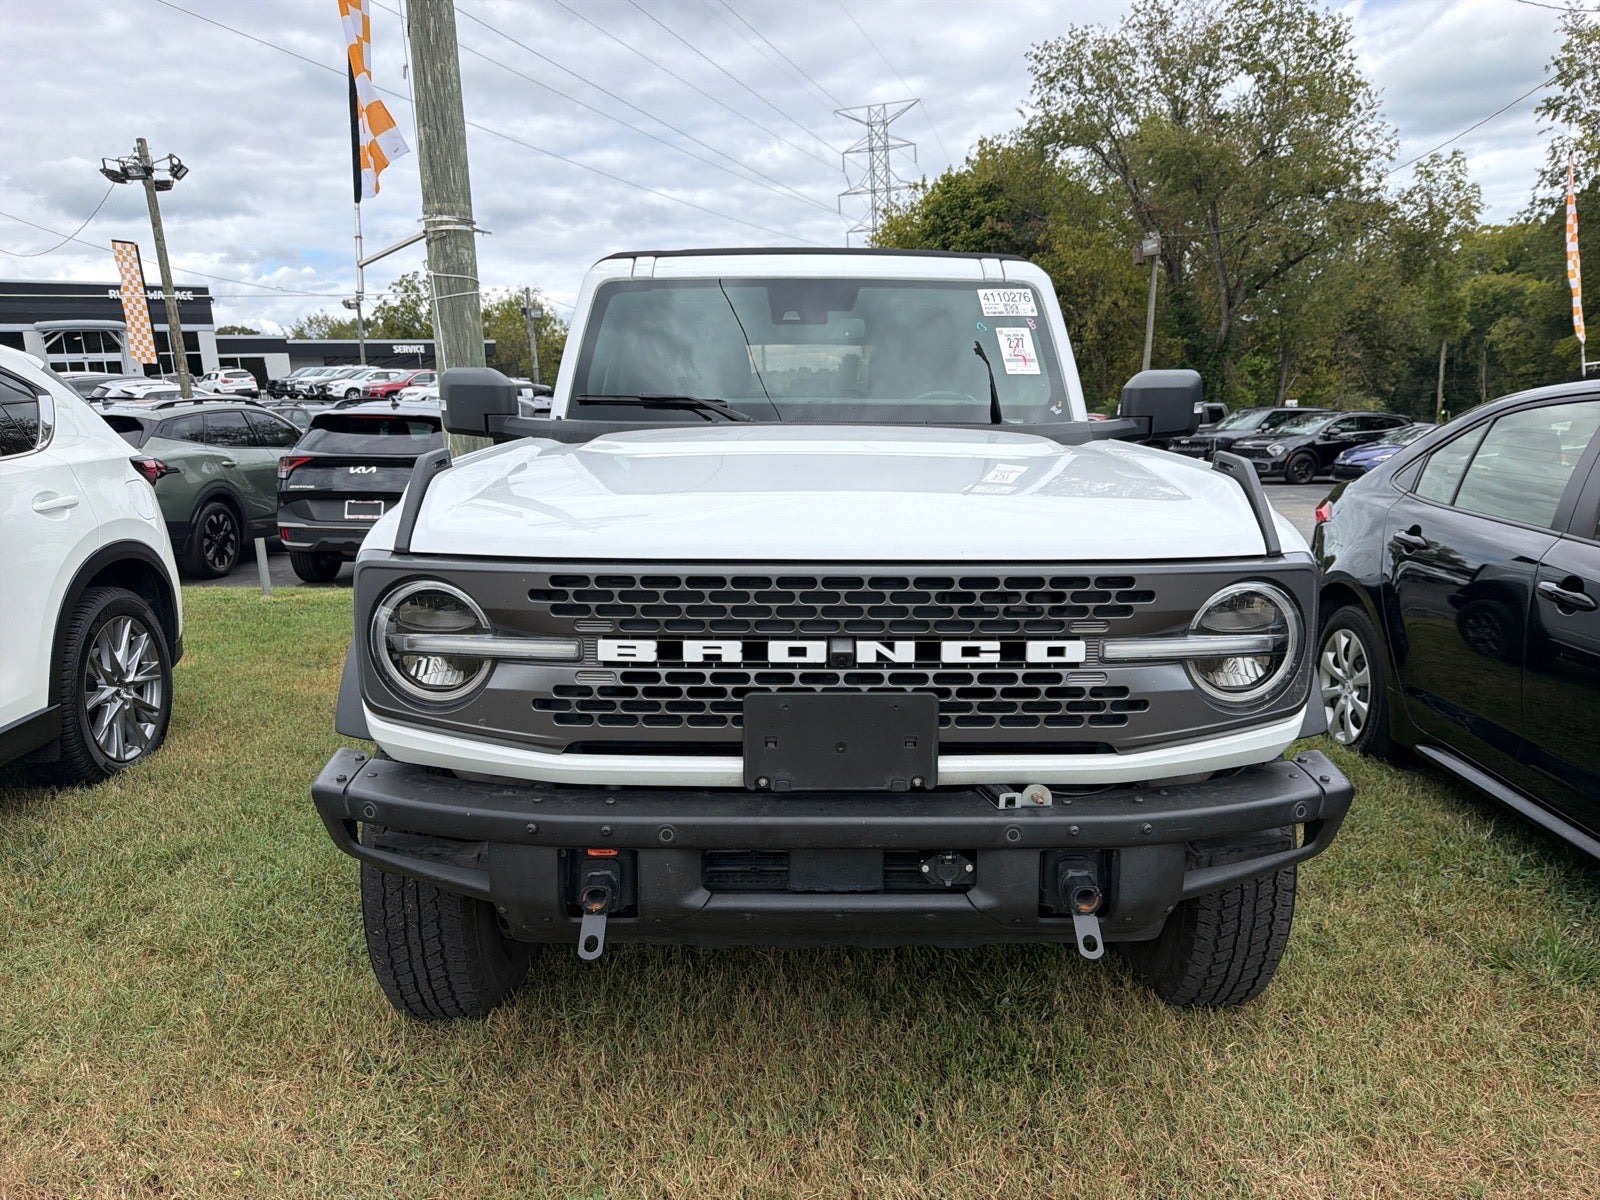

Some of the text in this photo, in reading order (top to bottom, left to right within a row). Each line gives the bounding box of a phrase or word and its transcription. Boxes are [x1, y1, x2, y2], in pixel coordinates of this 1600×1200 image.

[146, 290, 194, 300] WAACE
[983, 292, 1031, 302] 4110276
[392, 344, 426, 354] SERVICE
[597, 639, 1086, 663] BRONCO
